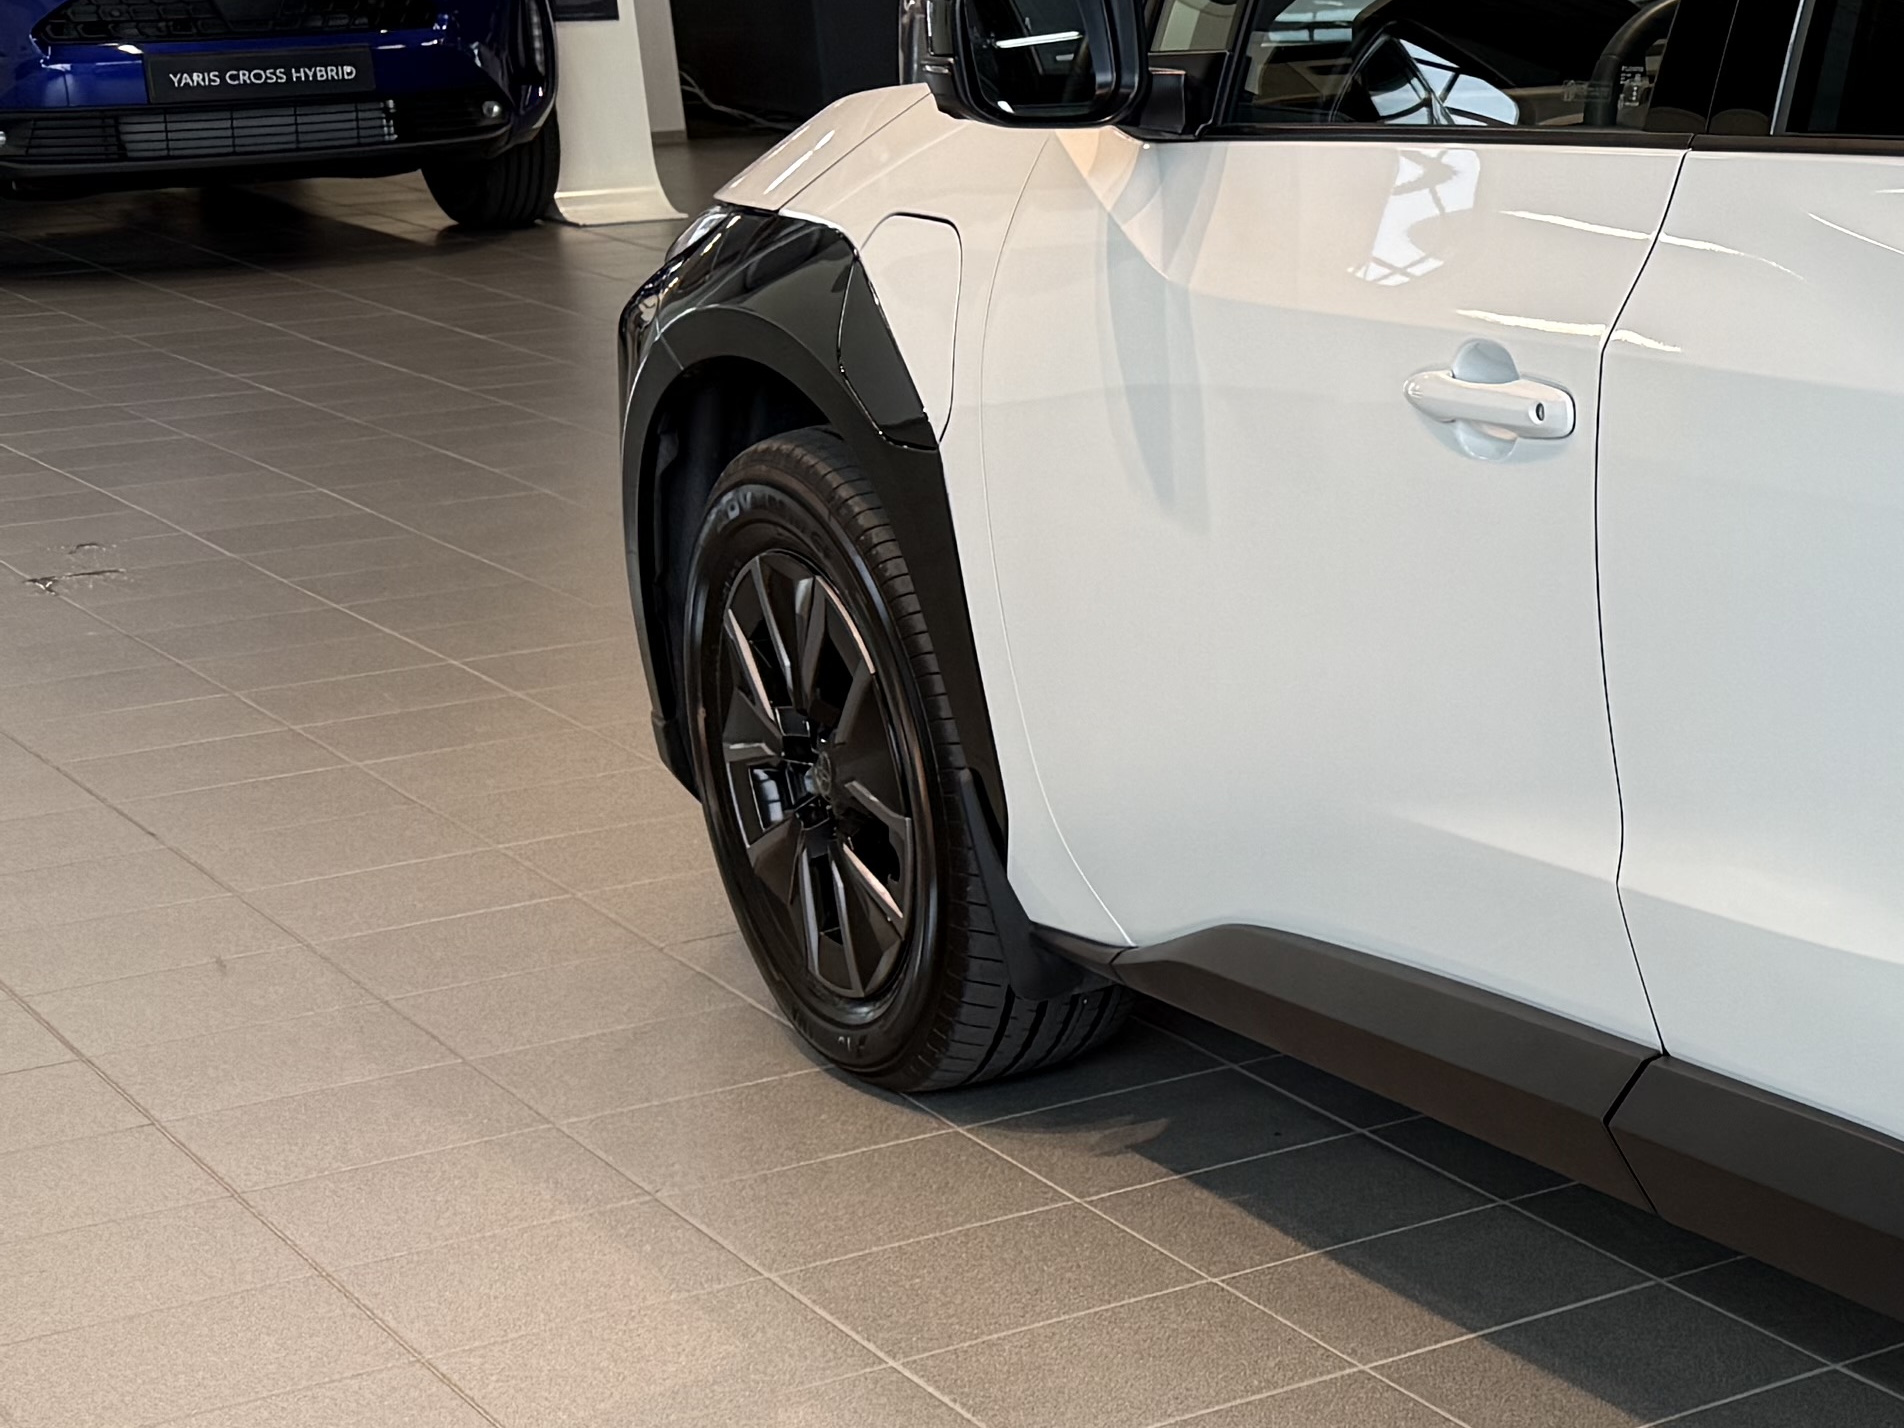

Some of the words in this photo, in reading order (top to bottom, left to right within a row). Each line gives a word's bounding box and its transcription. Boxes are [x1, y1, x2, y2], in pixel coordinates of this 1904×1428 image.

[169, 71, 220, 88] YARIS
[225, 68, 287, 85] CROSS
[291, 65, 356, 82] HYBRID
